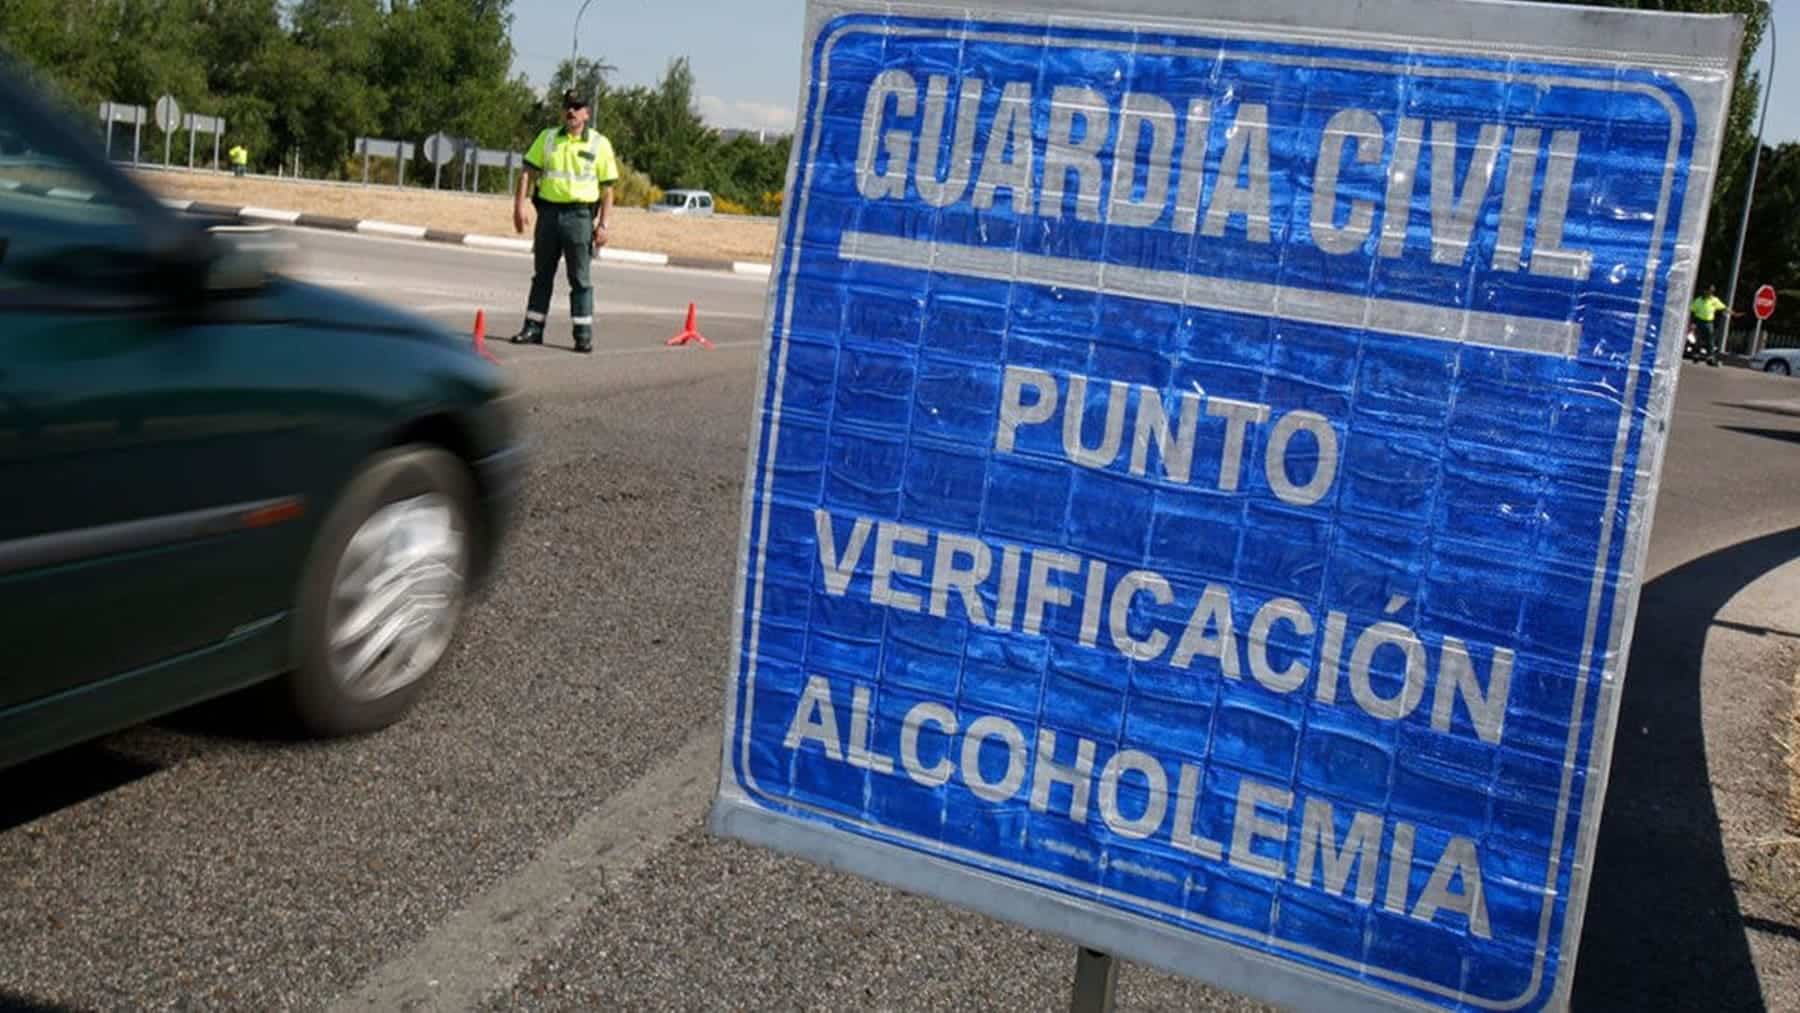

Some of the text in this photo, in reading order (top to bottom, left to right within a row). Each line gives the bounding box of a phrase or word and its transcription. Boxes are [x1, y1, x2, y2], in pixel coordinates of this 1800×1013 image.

[856, 69, 1591, 280] GUARDIA CIVIL
[997, 365, 1341, 506] PUNTO
[814, 509, 1515, 745] VERIFICACIÓN
[783, 675, 1492, 940] ALCOHOLEMIA
